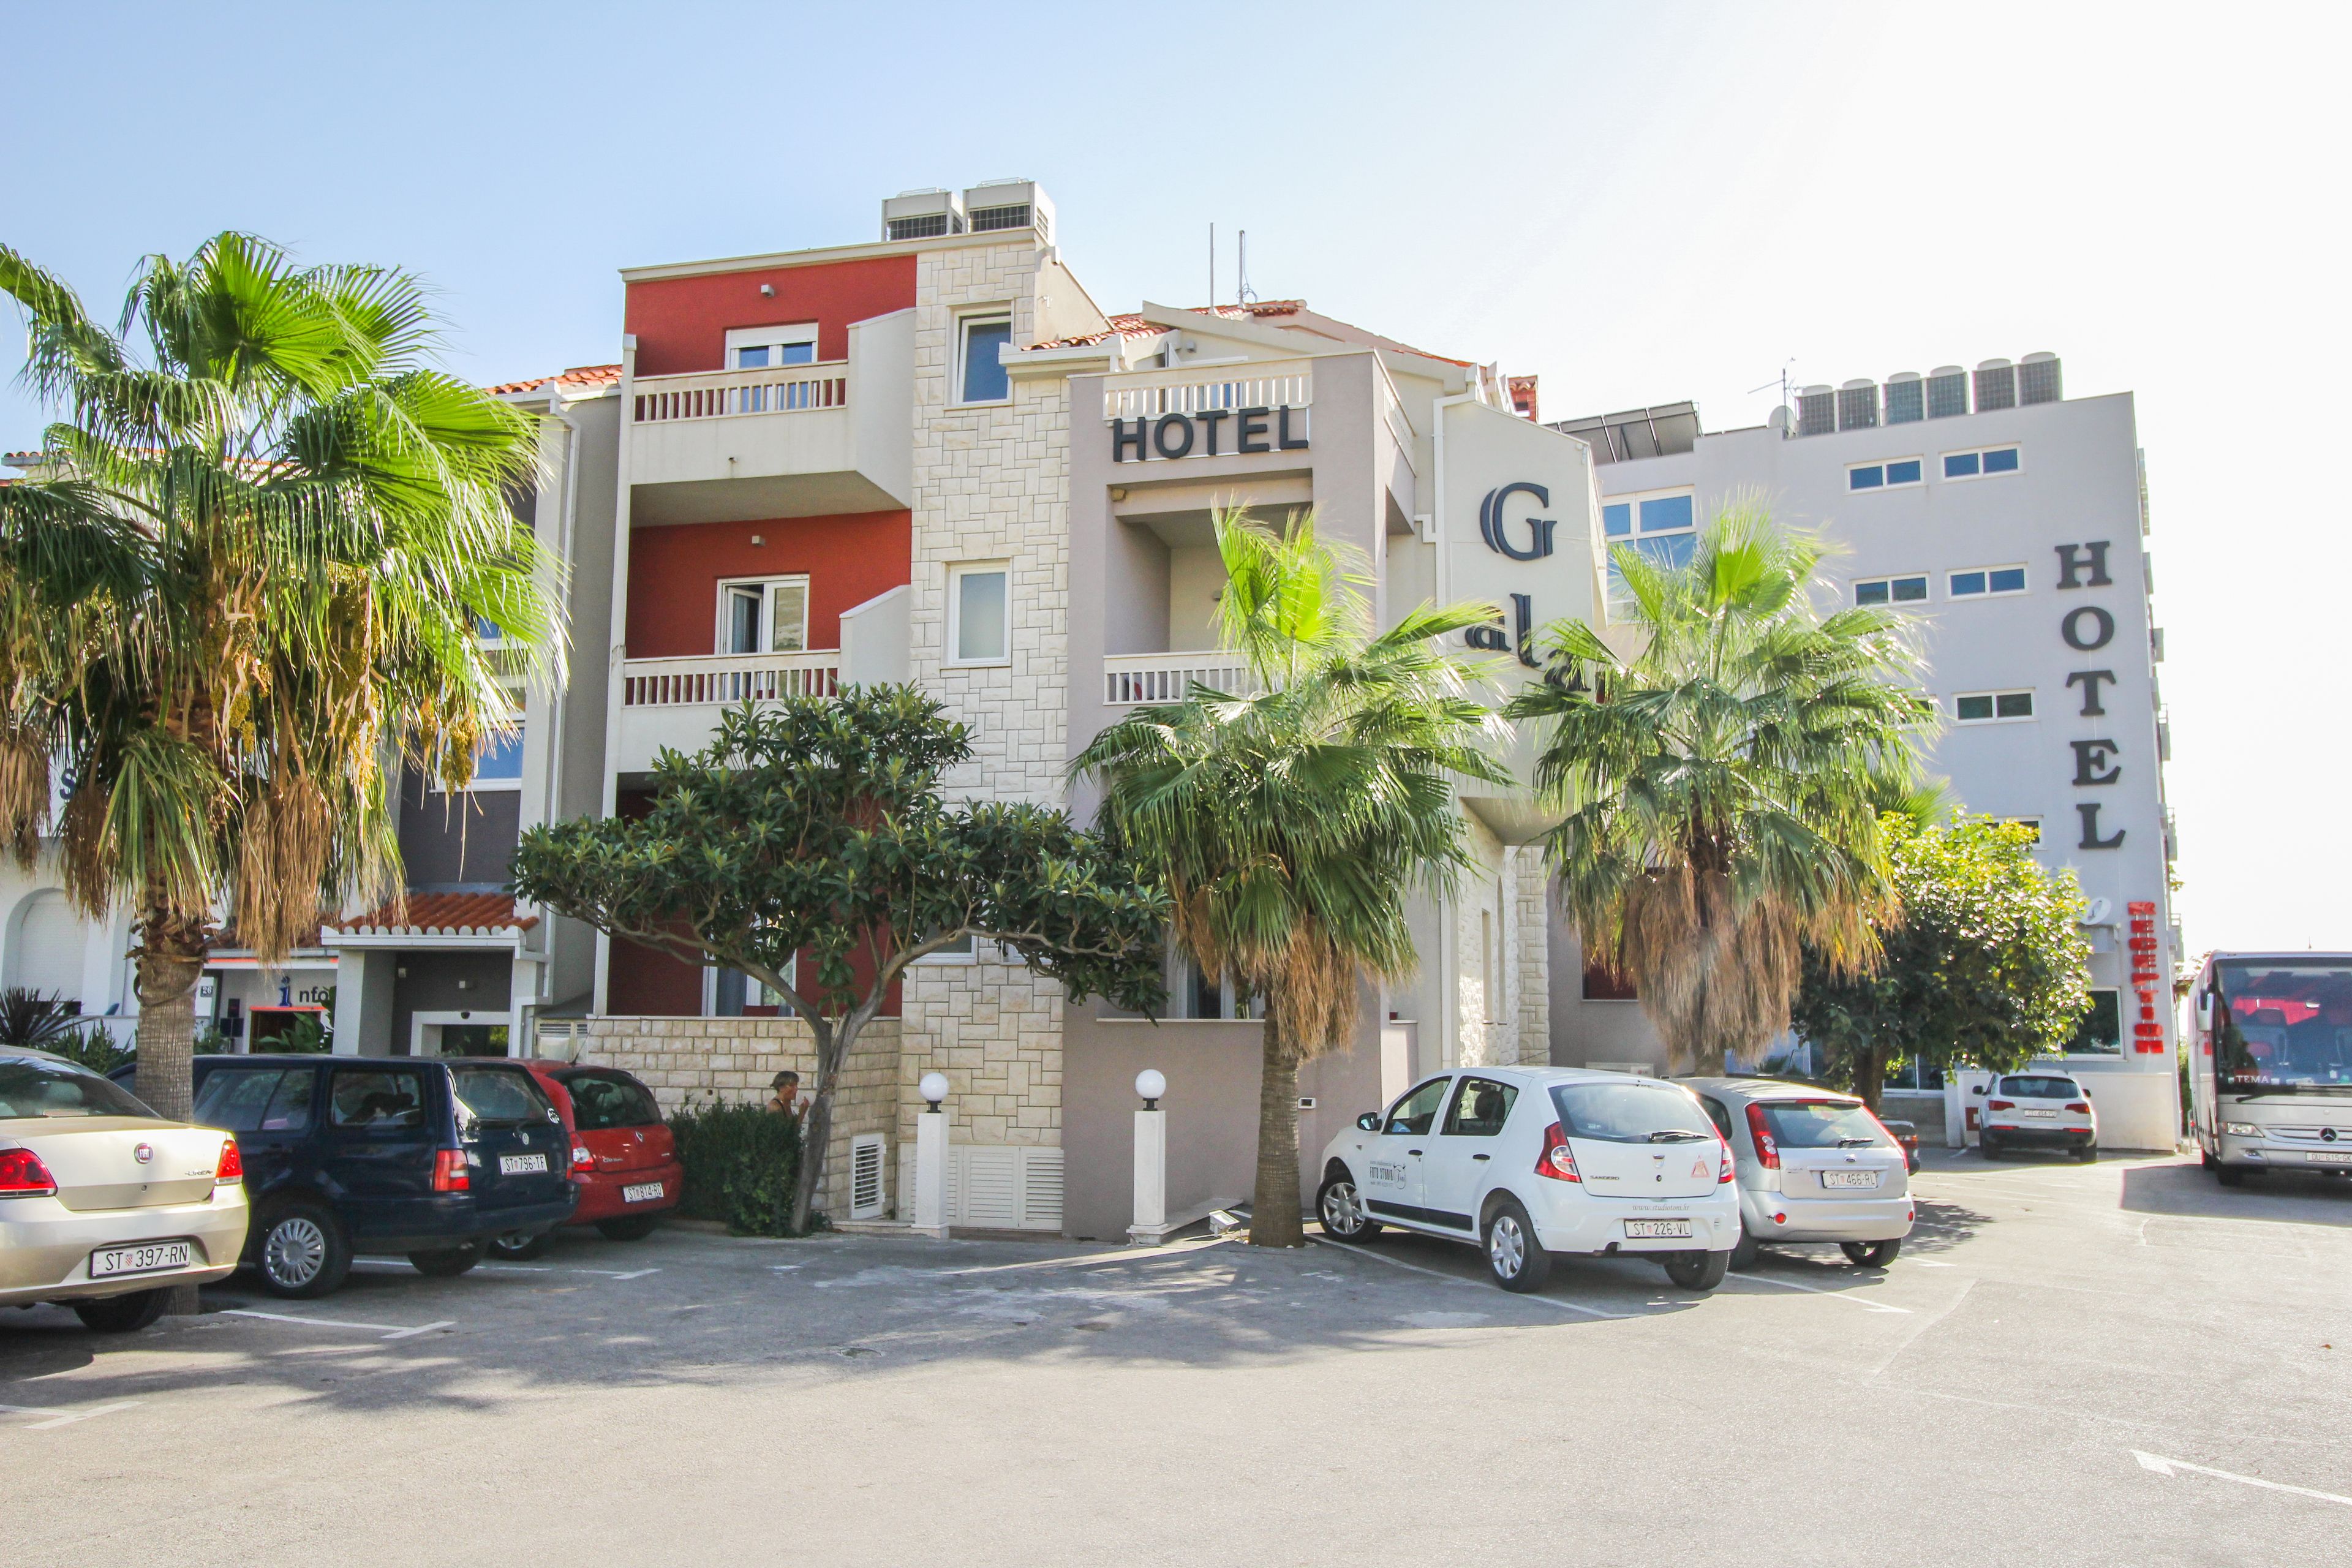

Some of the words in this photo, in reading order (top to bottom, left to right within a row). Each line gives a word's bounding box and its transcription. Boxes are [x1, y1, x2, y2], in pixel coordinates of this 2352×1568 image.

[1113, 405, 1309, 462] HOTEL
[2054, 540, 2126, 850] HOTEL
[2127, 901, 2164, 1054] RECEPTION
[202, 986, 213, 995] 26
[2236, 1075, 2269, 1084] TEMA
[138, 1148, 150, 1158] FIAT
[2311, 1152, 2321, 1161] DU
[505, 1158, 514, 1172] ST
[519, 1156, 544, 1170] 796-TF
[1830, 1174, 1839, 1185] ST
[1846, 1174, 1875, 1185] 466-RL
[628, 1188, 636, 1199] ST
[1632, 1203, 1690, 1212] www.studiotoni.hr
[1634, 1223, 1645, 1236] ST
[1654, 1223, 1690, 1235] 226-VL
[105, 1251, 123, 1272] ST
[135, 1245, 188, 1268] 397-RN
